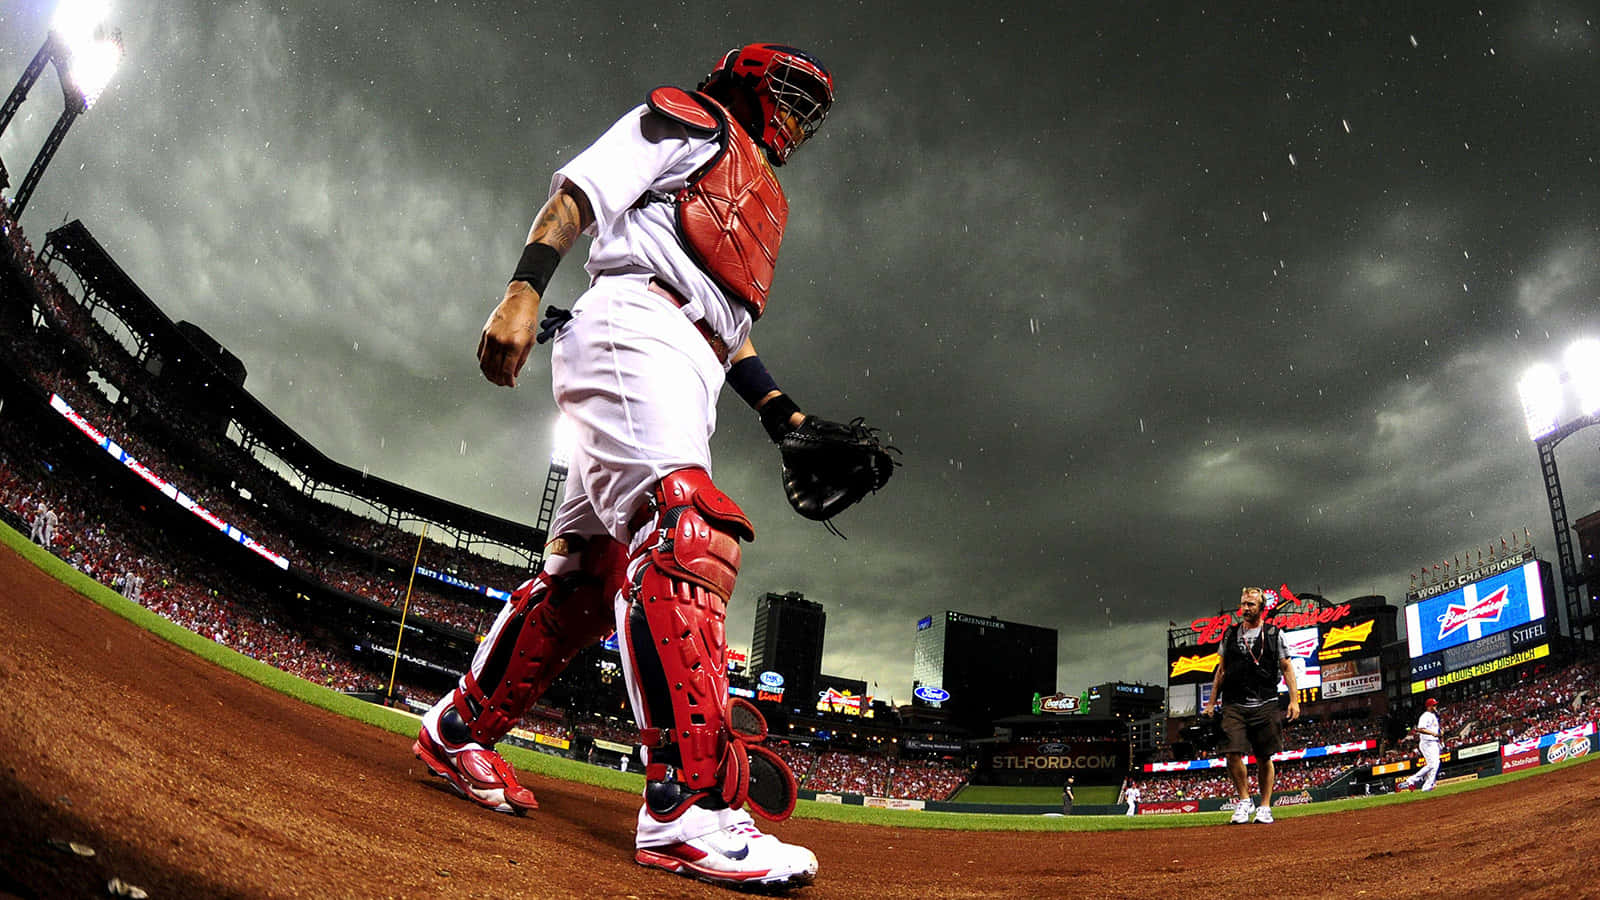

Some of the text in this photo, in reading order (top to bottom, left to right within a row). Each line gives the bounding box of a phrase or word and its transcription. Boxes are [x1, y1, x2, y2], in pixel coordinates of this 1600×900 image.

[1417, 554, 1523, 598] WORLD CHAMPIONS
[1437, 596, 1510, 628] Budweiser
[1513, 624, 1546, 644] STIFEL
[1418, 661, 1442, 672] DELTA
[1340, 675, 1380, 688] HELITECH
[921, 688, 944, 699] Ford
[1548, 746, 1567, 760] Gulf
[1570, 740, 1589, 754] Gulf
[992, 755, 1117, 769] STLFORD.COM
